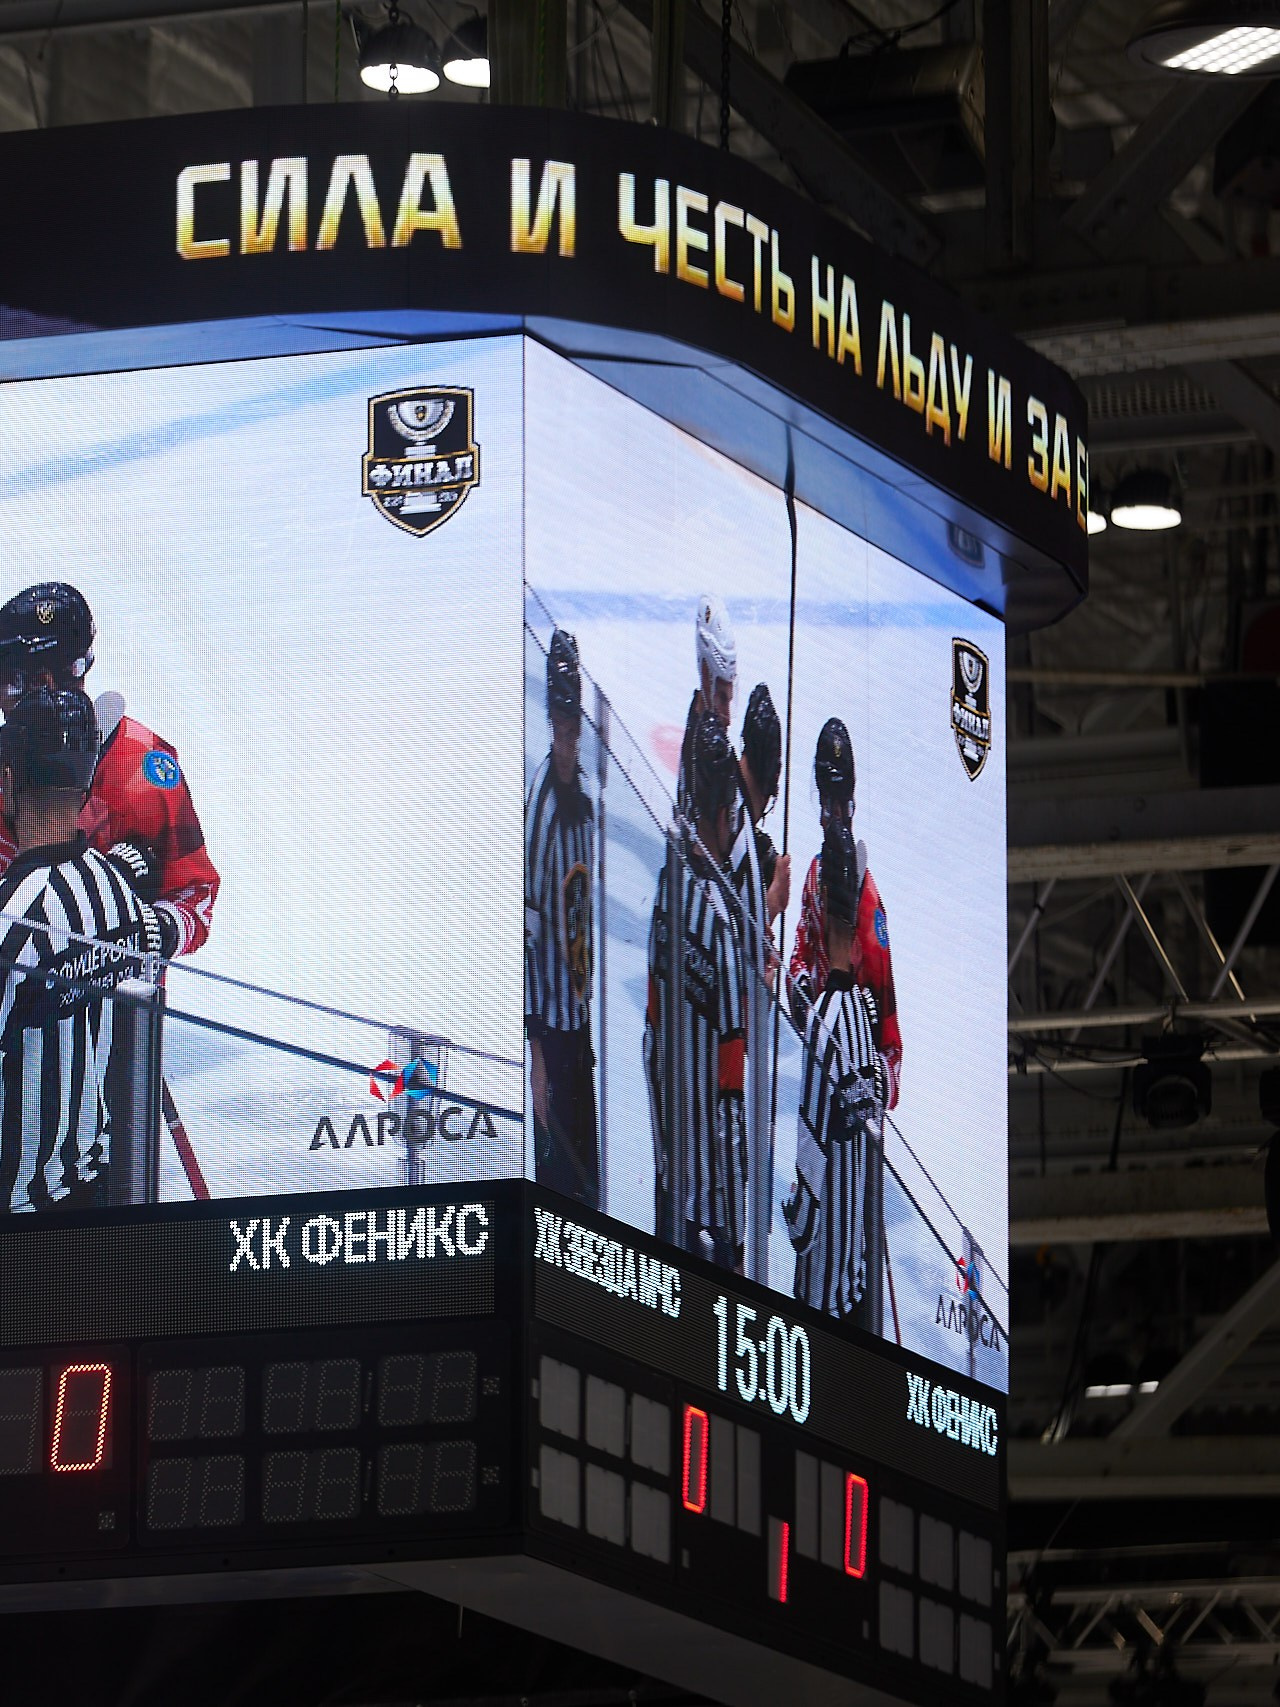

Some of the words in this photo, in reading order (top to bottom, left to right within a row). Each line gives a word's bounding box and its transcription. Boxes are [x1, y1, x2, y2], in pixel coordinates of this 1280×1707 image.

[176, 152, 463, 260] СИЛА
[510, 158, 576, 258] И
[618, 172, 796, 333] ЧЕСТЬ
[811, 254, 863, 376] НА
[876, 299, 974, 447] ЛЬДУ
[987, 368, 1013, 471] И
[368, 453, 474, 488] ФИНАЛ
[228, 1217, 292, 1272] ХК
[301, 1203, 490, 1265] ФЕНИКС
[713, 1296, 812, 1424] 15:00
[50, 1363, 112, 1472] 0
[682, 1403, 709, 1514] 0
[843, 1471, 869, 1579] 0
